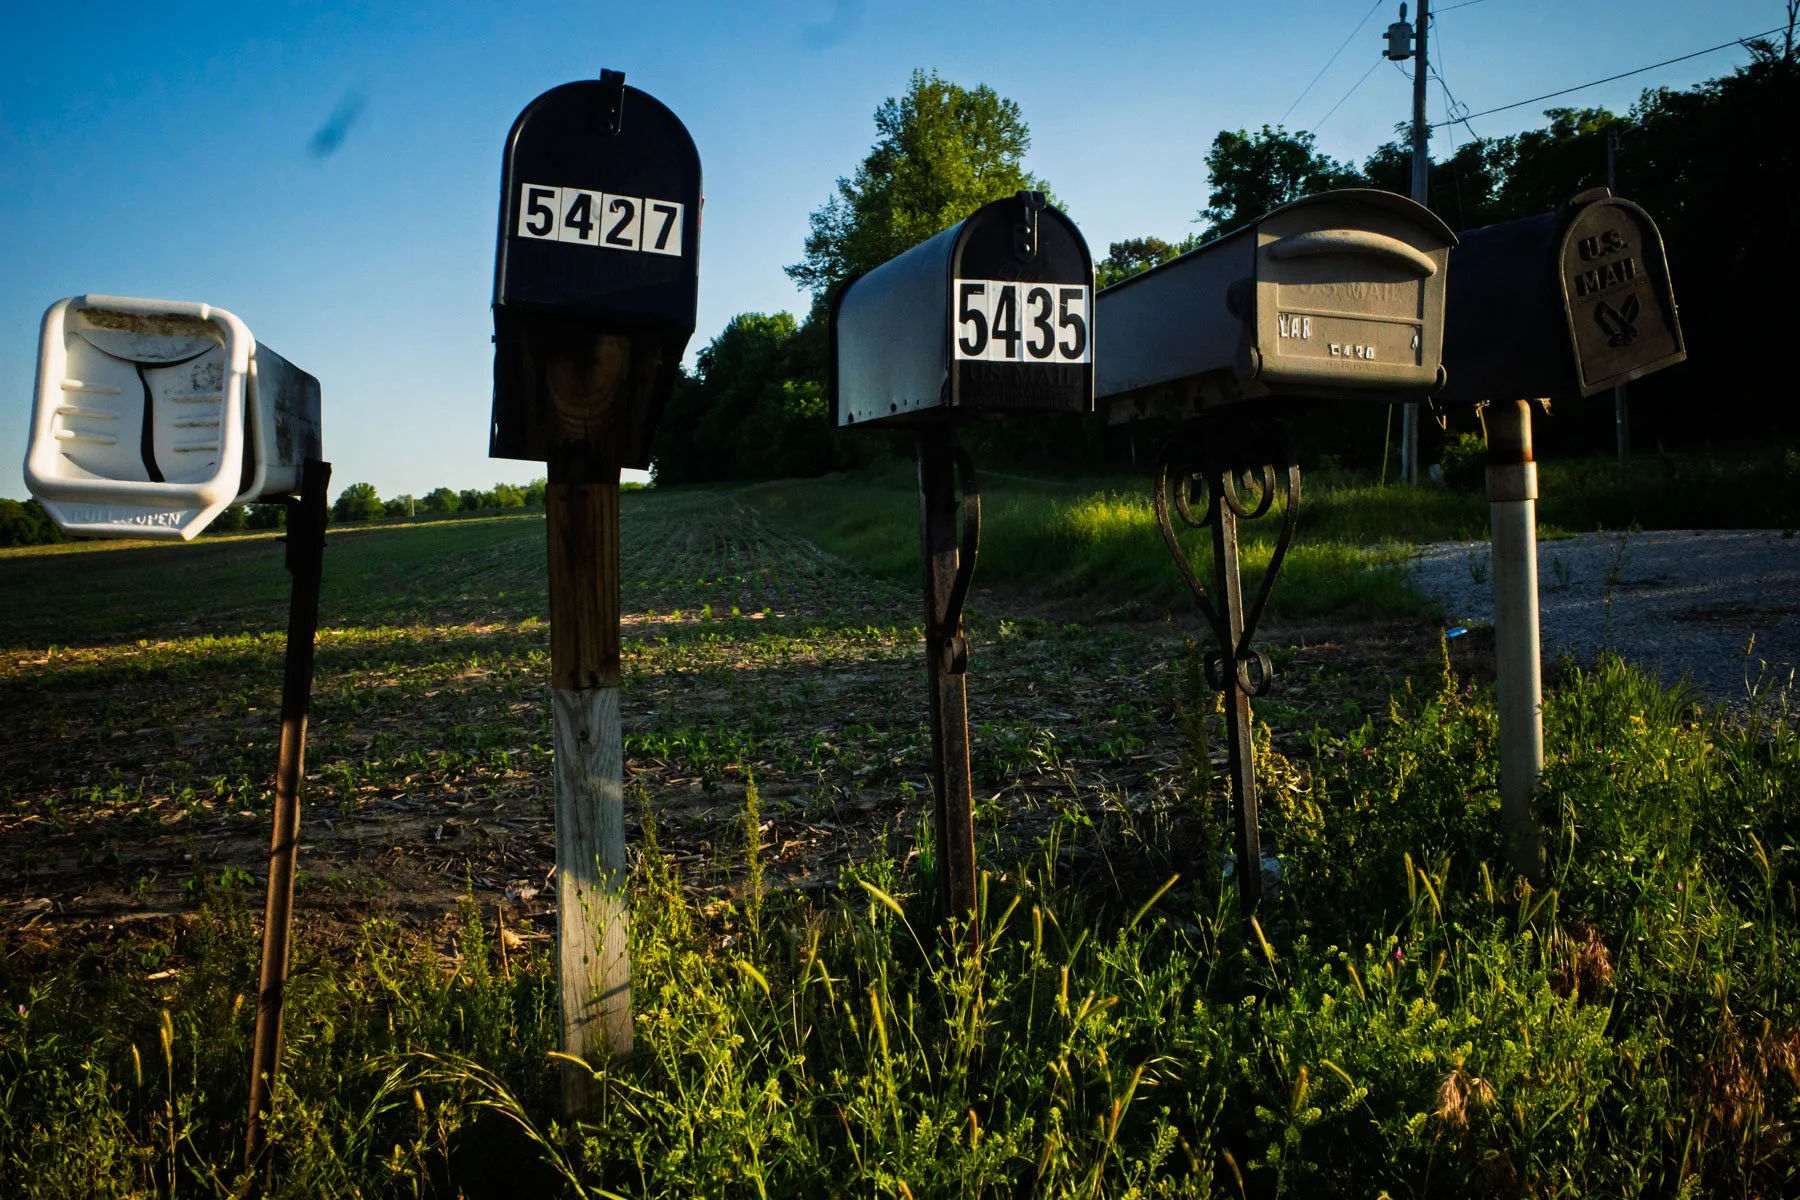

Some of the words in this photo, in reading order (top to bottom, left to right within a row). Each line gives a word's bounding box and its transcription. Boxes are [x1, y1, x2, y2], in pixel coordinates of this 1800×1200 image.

[526, 188, 678, 250] 5427
[1575, 257, 1638, 296] MAIL
[958, 283, 1087, 360] 5435
[1015, 365, 1080, 385] MAIL
[135, 512, 182, 526] OPEN
